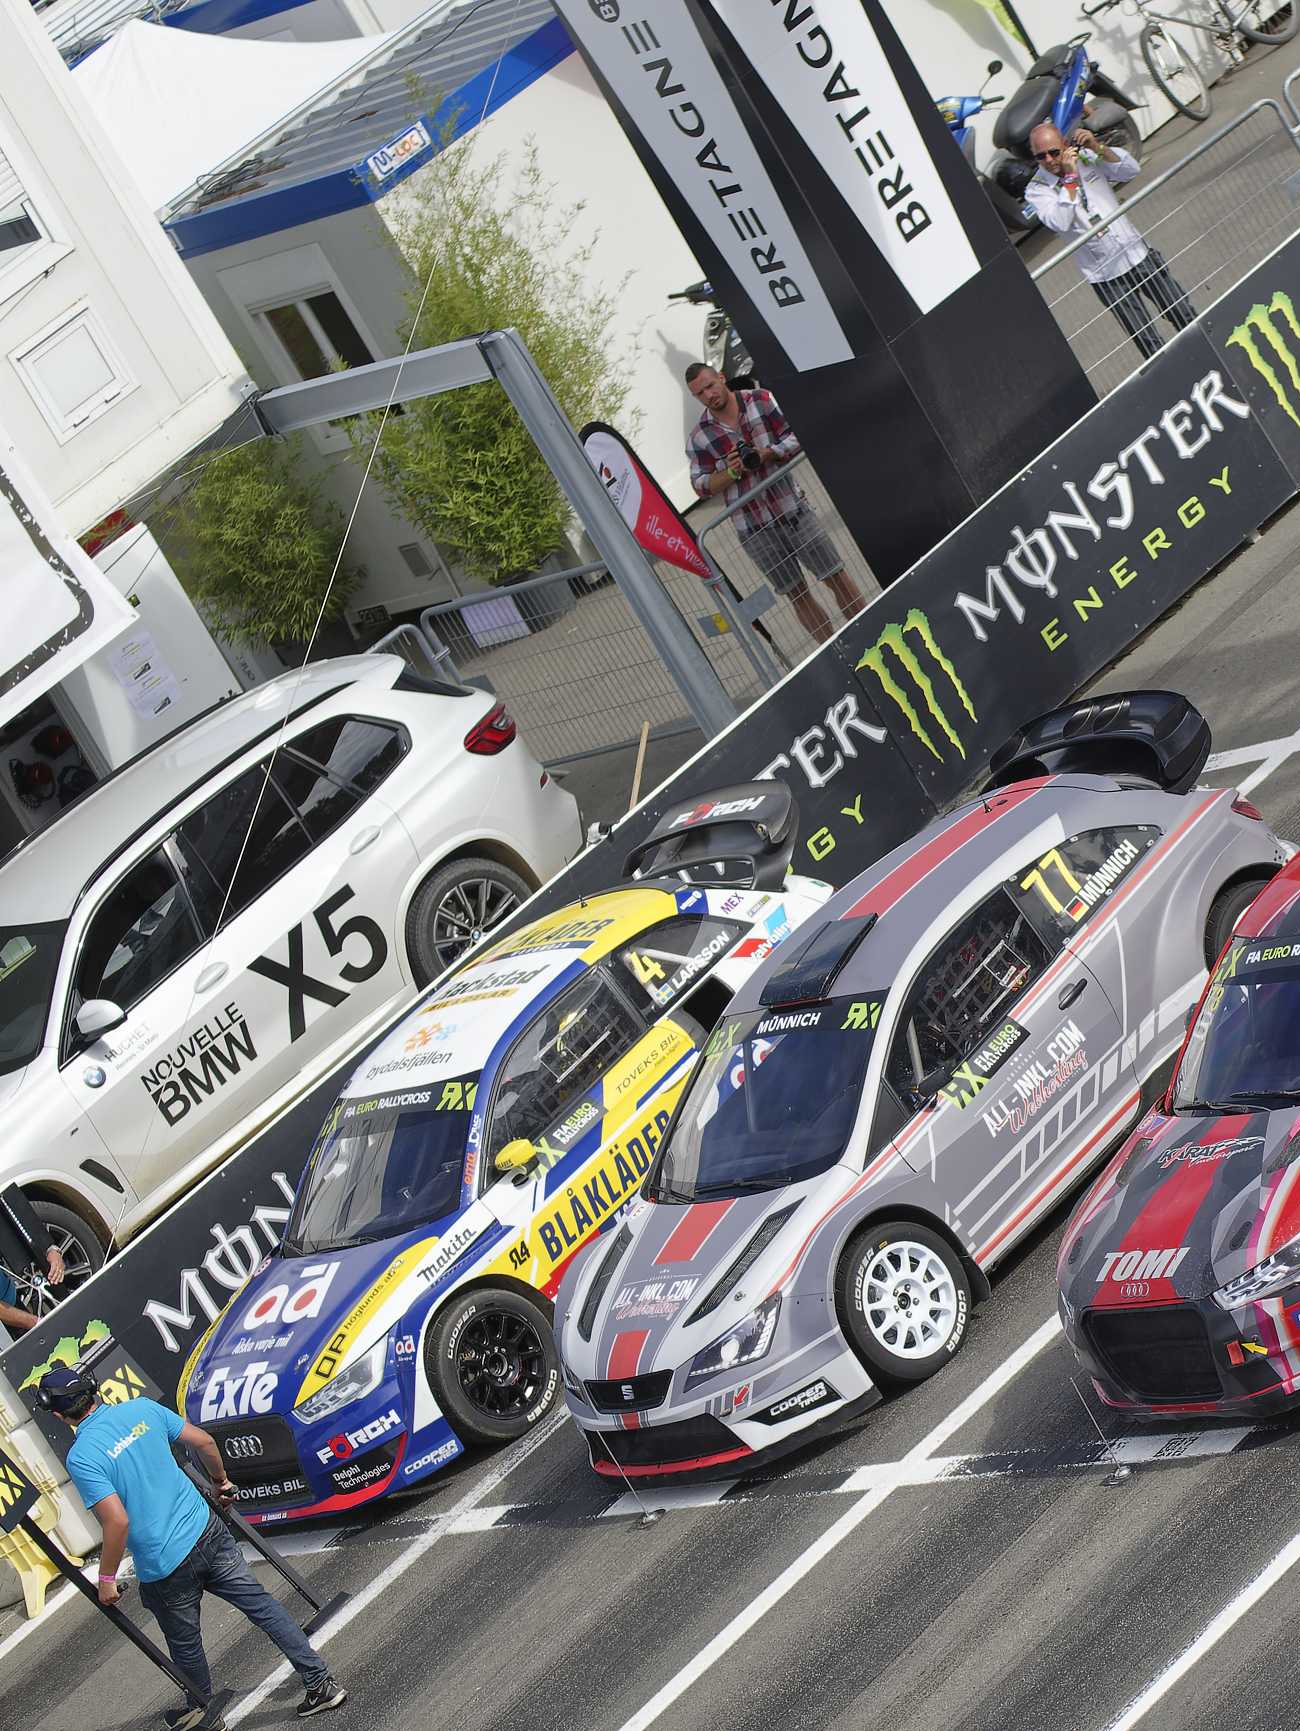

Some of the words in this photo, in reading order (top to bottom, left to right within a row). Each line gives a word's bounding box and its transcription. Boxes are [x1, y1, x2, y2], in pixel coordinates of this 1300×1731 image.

[621, 20, 805, 308] BRETAGNE
[1040, 465, 1234, 652] ENERGY
[1020, 849, 1082, 914] 77
[1078, 839, 1140, 908] MÜNNICH
[720, 892, 744, 915] MEX
[247, 883, 389, 1045] X5
[628, 952, 666, 984] 4
[672, 931, 731, 989] LARSSON
[1245, 950, 1261, 965] FIA
[1262, 945, 1291, 961] EURO
[756, 1012, 822, 1035] MÜNNICH
[140, 1001, 245, 1092] NOUVELLE
[616, 1049, 659, 1095] TOVEKS
[659, 1033, 678, 1052] BIL
[973, 1050, 994, 1068] FIA
[988, 1024, 1015, 1051] EURO
[982, 1029, 1022, 1072] RALLYCROSS
[151, 1020, 259, 1128] BMW
[356, 1099, 379, 1115] EURO
[378, 1091, 432, 1110] RALLYCROSS
[565, 1102, 593, 1126] EURO
[560, 1107, 599, 1144] RALLYCROSS
[855, 1247, 876, 1312] COOPER
[1095, 1247, 1191, 1283] TOMI
[447, 1305, 477, 1360] COOPER
[945, 1289, 967, 1354] COOPER
[200, 1361, 279, 1423] ExTe
[526, 1368, 559, 1424] COOPER
[769, 1382, 827, 1417] COOPER
[798, 1389, 829, 1410] TIRES
[332, 1464, 361, 1483] Delphi
[337, 1462, 391, 1491] Technologies
[404, 1440, 457, 1477] COOPER
[283, 1479, 305, 1495] BIL
